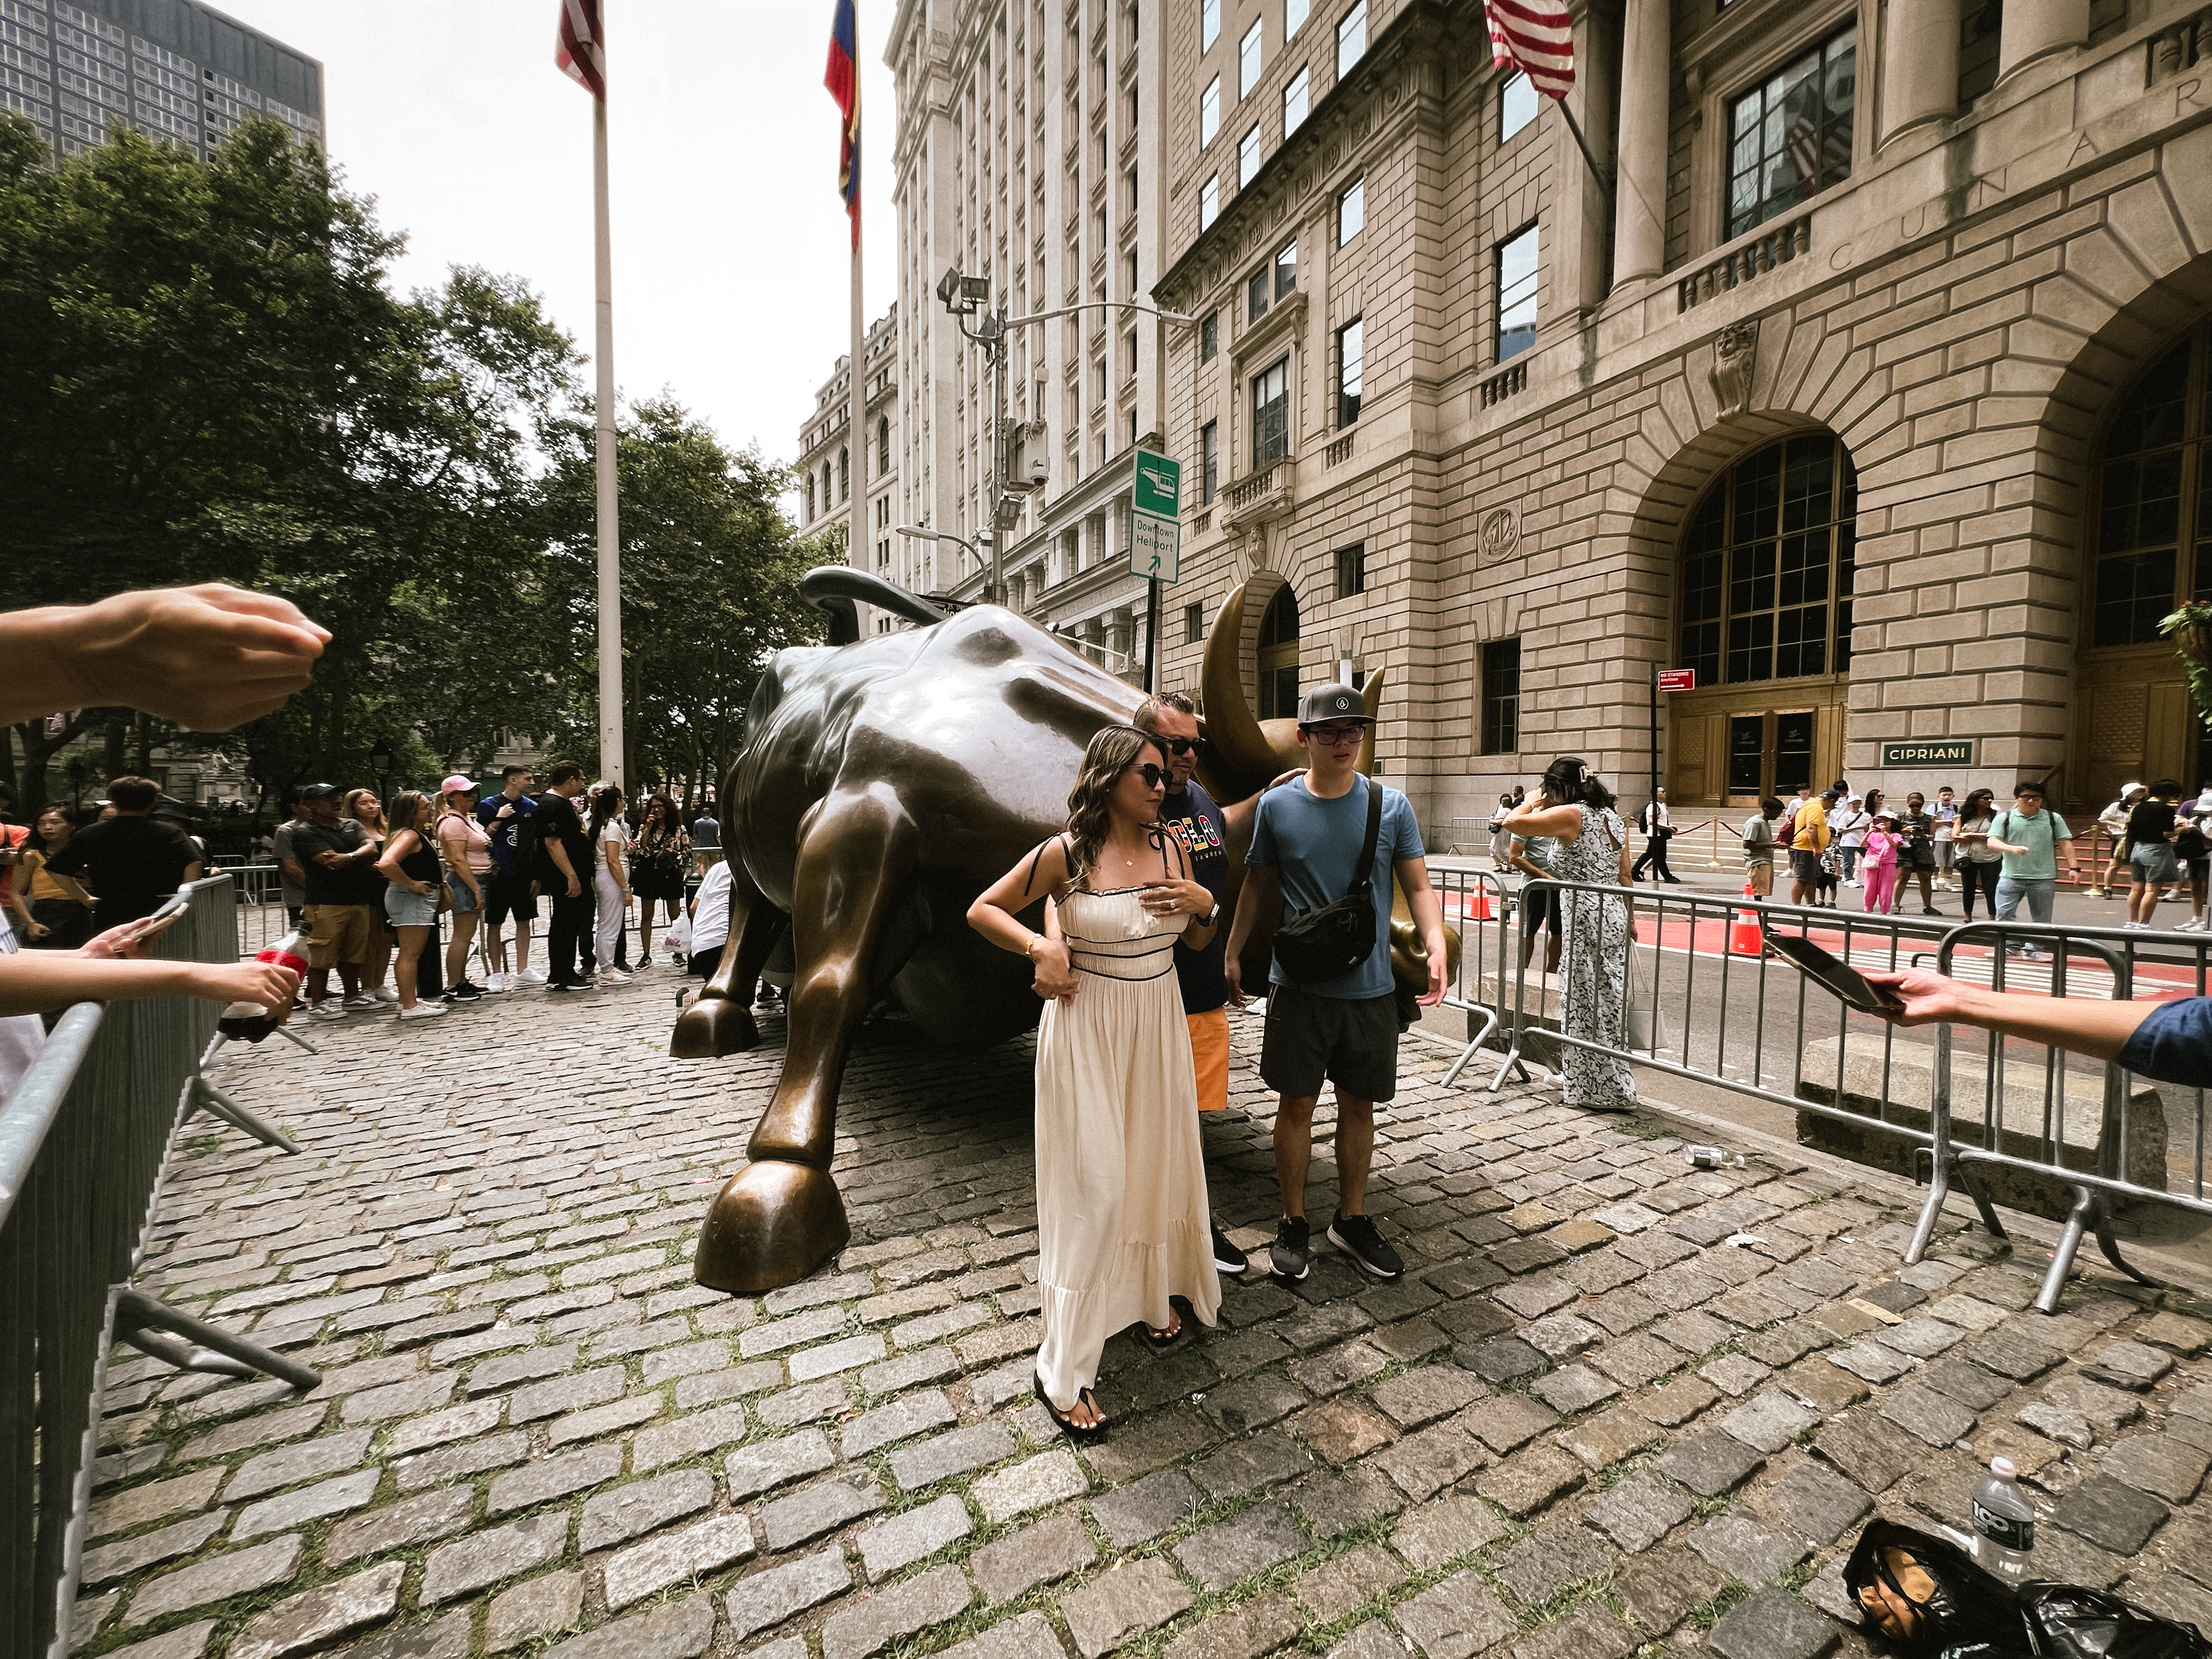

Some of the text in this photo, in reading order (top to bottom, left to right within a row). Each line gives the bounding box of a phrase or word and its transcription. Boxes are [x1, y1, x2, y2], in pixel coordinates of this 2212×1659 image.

[1137, 520, 1174, 538] Downtown
[1137, 534, 1173, 552] Heliport
[1889, 747, 1965, 760] CIPRIANI
[1163, 815, 1220, 853] OLO
[1195, 850, 1222, 861] LAUREN
